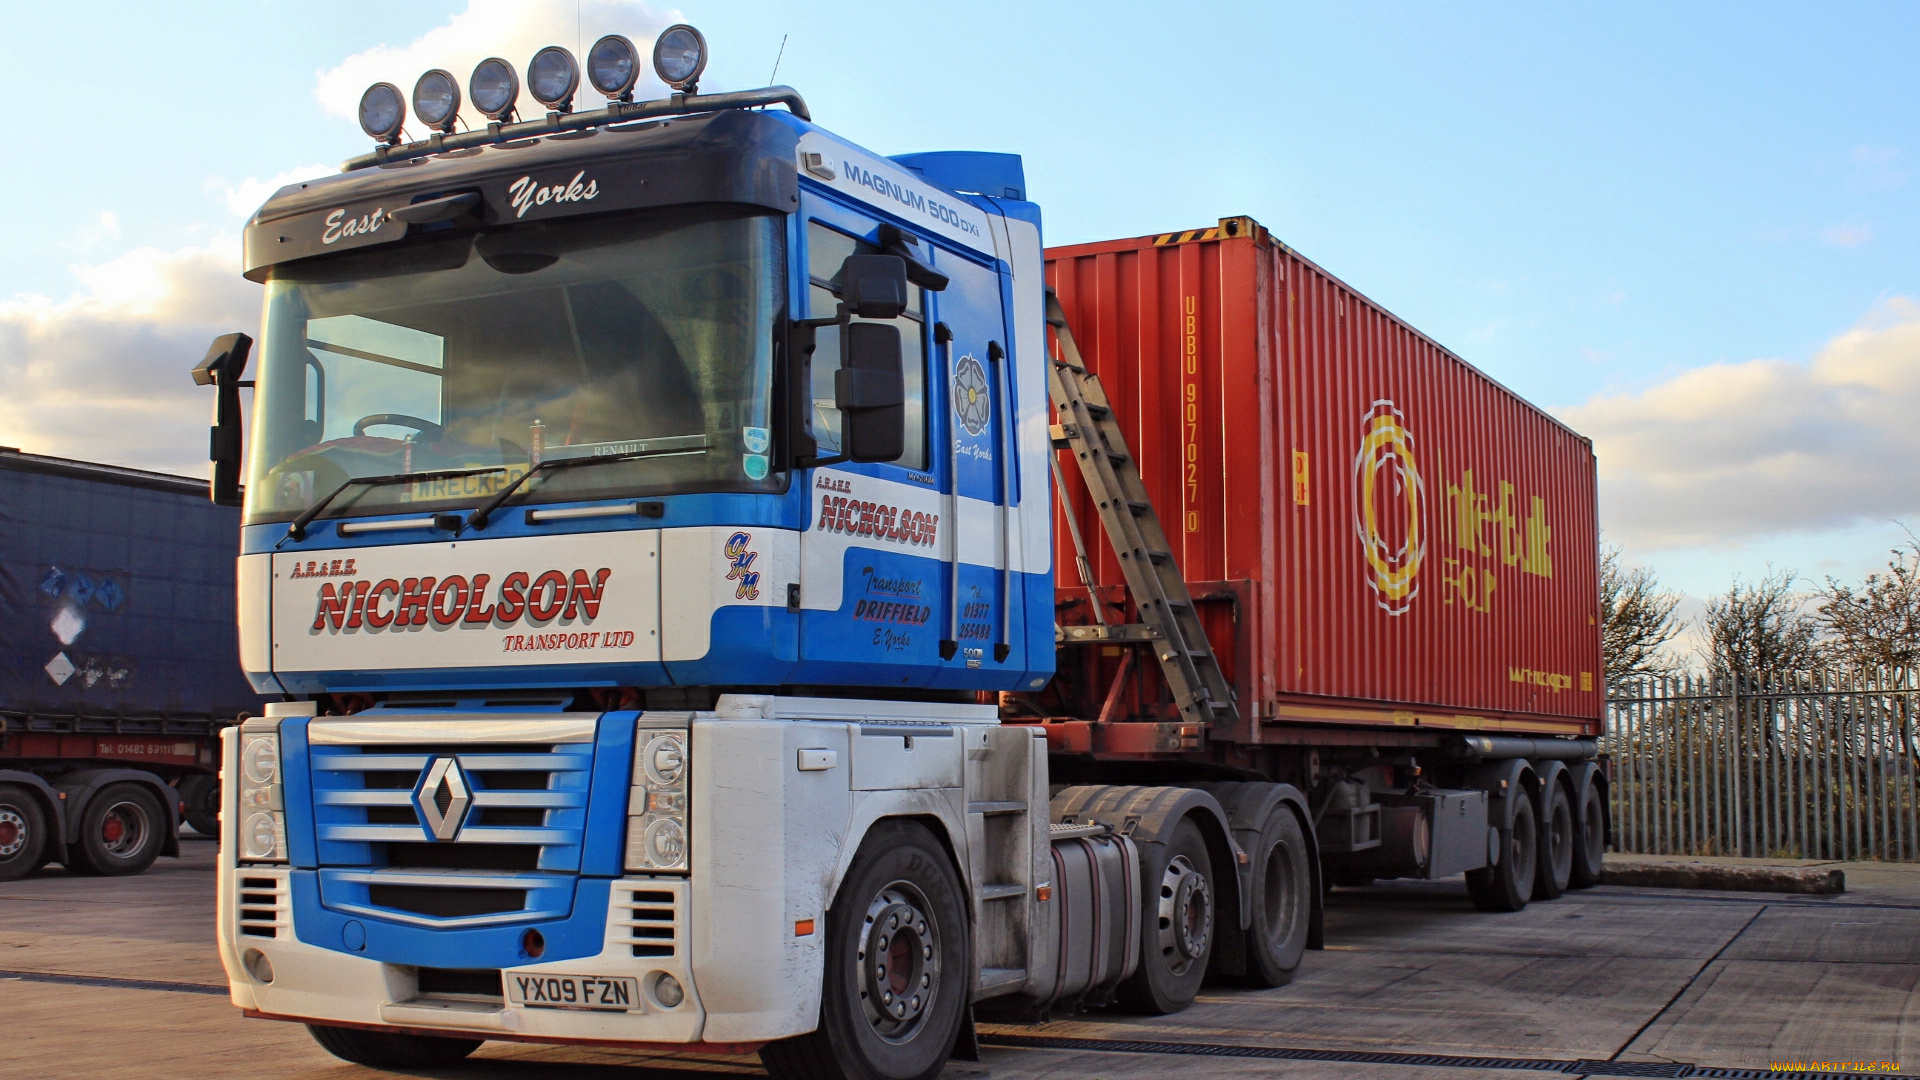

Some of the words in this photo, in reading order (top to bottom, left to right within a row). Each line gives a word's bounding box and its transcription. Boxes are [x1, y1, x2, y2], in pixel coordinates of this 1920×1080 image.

[843, 160, 926, 213] MAGNUM
[322, 207, 383, 244] East
[508, 170, 600, 218] Yorks
[1185, 296, 1196, 374] UBBU
[955, 440, 971, 455] East
[973, 444, 992, 461] Yorks
[1187, 383, 1198, 502] 907027
[418, 468, 524, 498] WRECKER
[819, 494, 939, 547] NICHOLSON
[862, 566, 922, 596] Transport
[312, 567, 611, 632] NICHOLSON
[854, 599, 931, 625] DRIFFIELD
[963, 602, 990, 620] 01377
[503, 632, 600, 651] TRANSPORT
[602, 630, 635, 648] LTD
[516, 976, 577, 1002] YX09
[581, 979, 630, 1005] FZN
